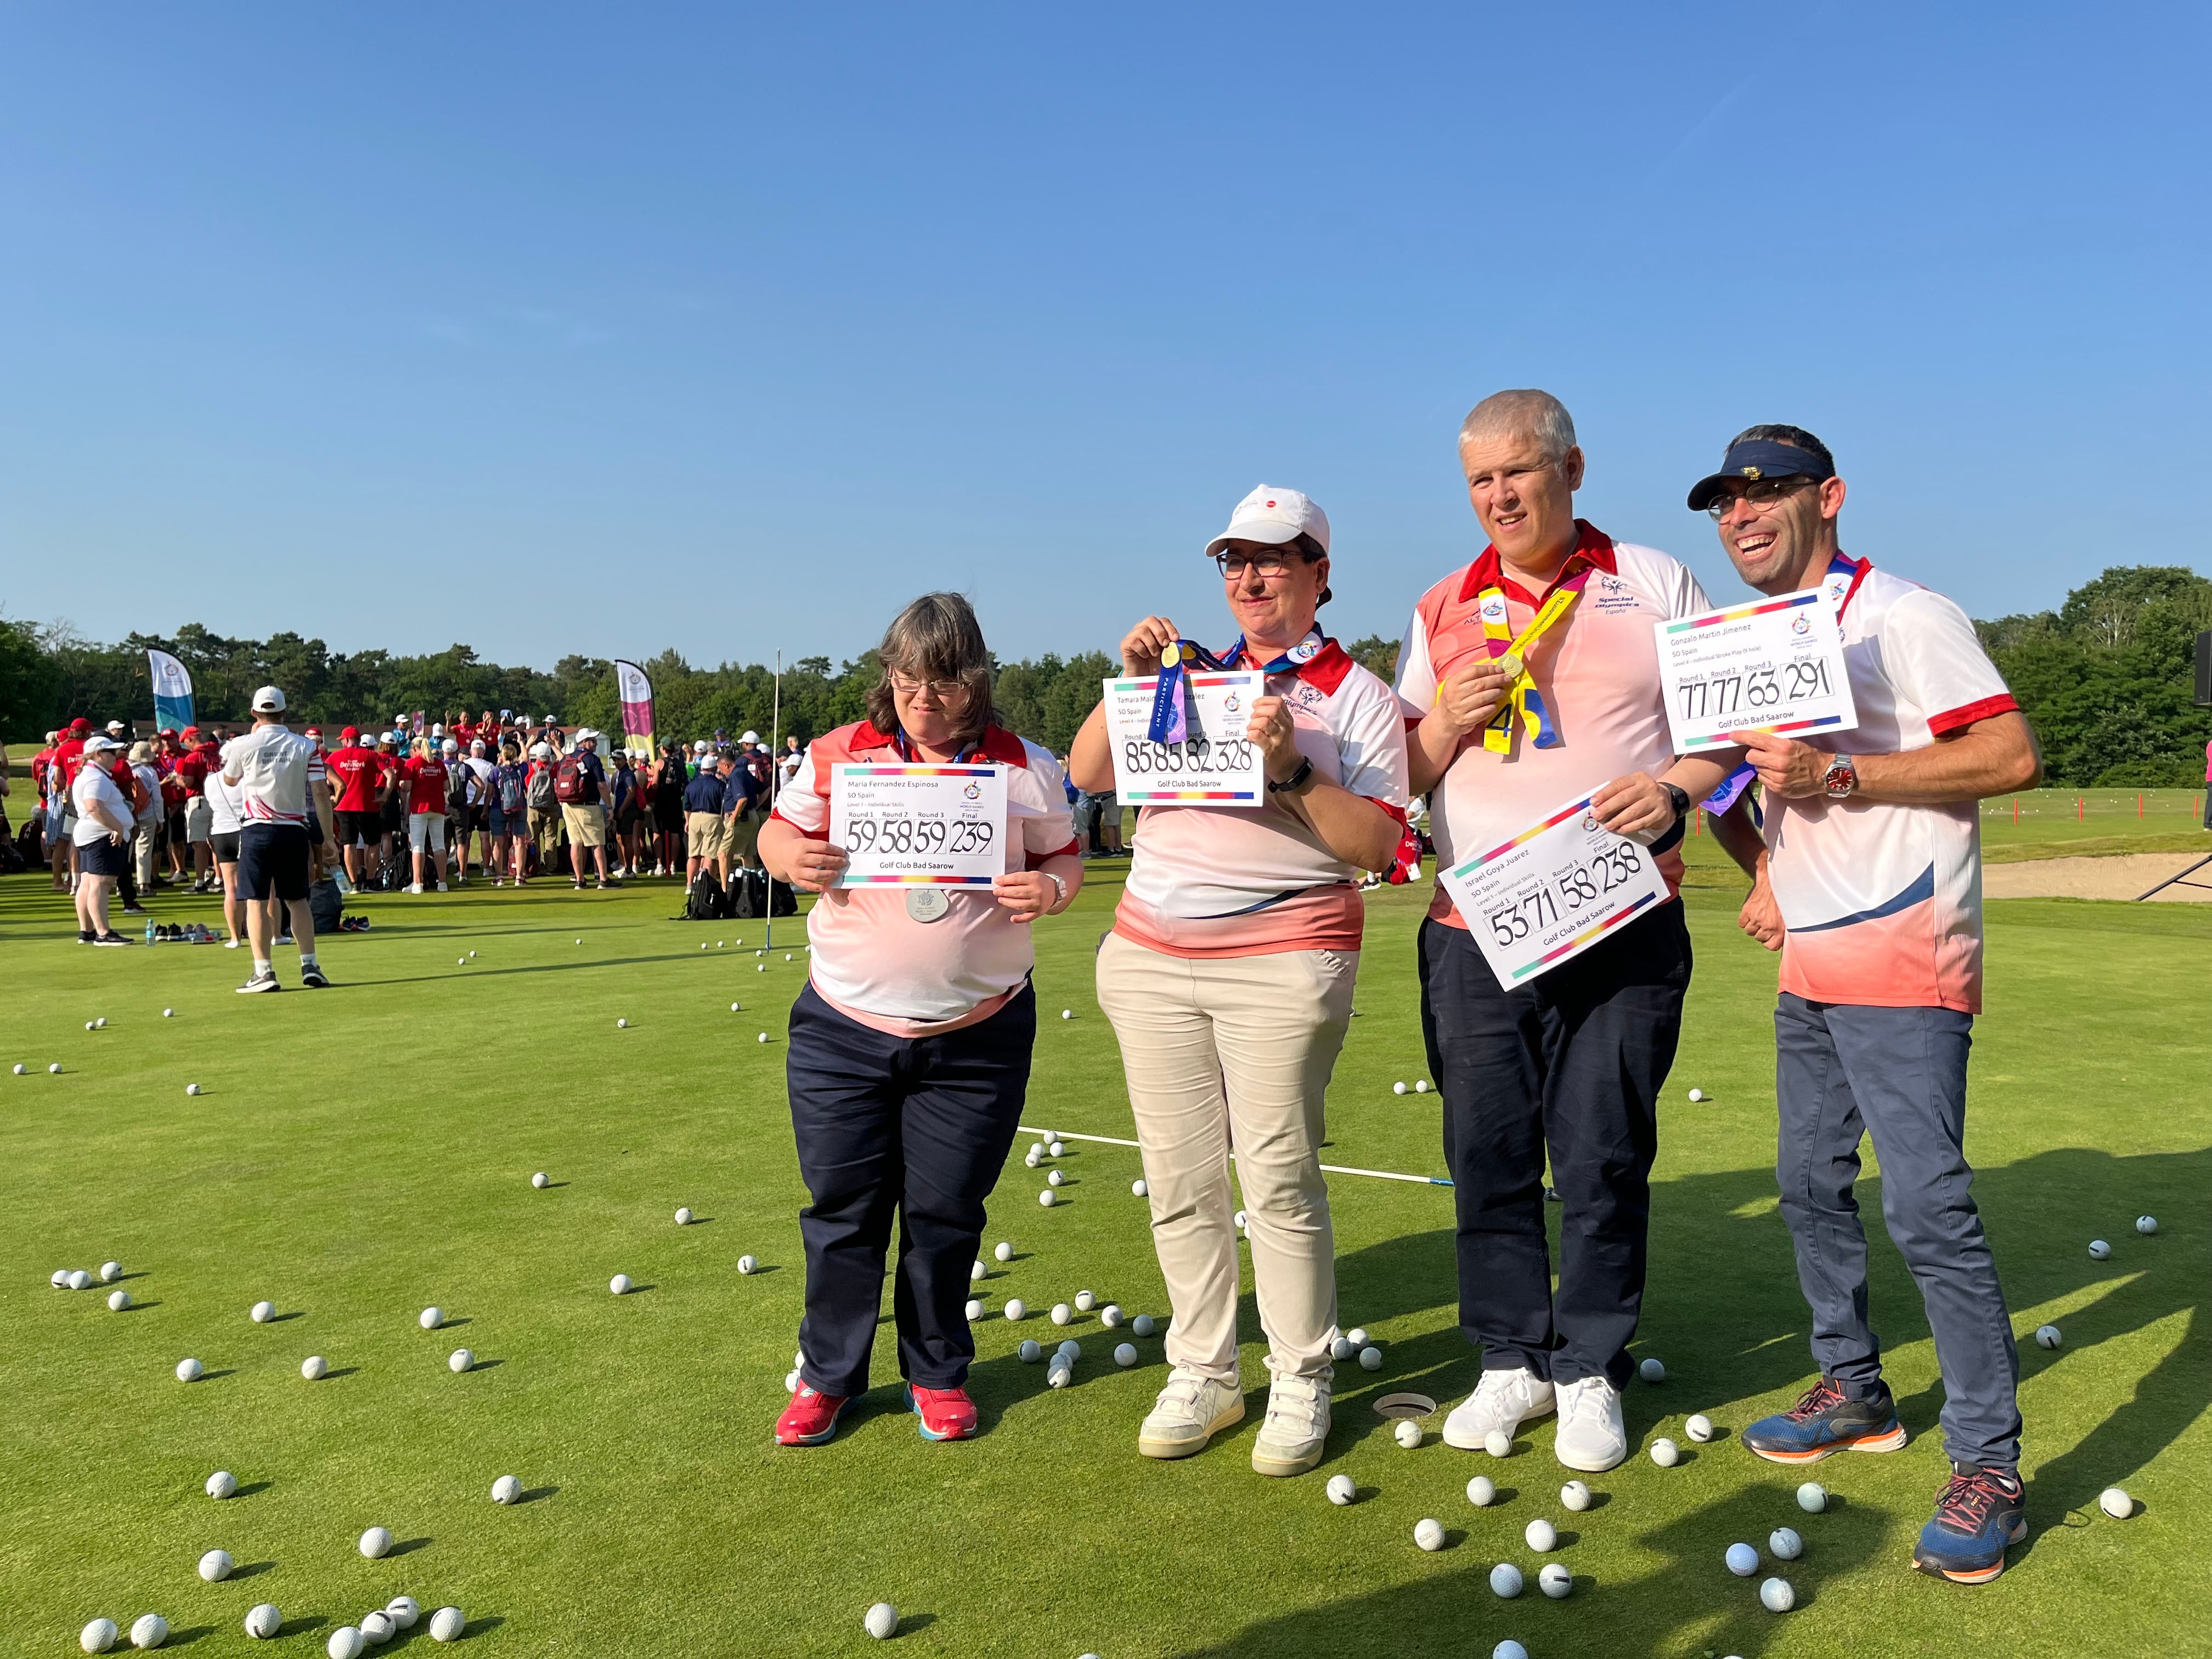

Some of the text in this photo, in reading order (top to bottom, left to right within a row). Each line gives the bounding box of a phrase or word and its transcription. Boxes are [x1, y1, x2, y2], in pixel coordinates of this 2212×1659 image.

[1671, 624, 1752, 646] Gonzalo Martin Jimenez
[1681, 648, 1698, 656] Spain
[1693, 654, 1715, 663] Individual
[1794, 653, 1811, 662] Final
[1711, 669, 1731, 677] Round
[1745, 662, 1765, 671] Round
[1679, 675, 1698, 683] Round
[1679, 658, 1830, 719] 77 77 63 291
[1155, 677, 1169, 727] PARTICIPANT
[1718, 711, 1794, 729] Golf Club Bad Saarow
[1126, 738, 1252, 774] 85 85 82 328
[846, 820, 993, 854] 59 58 59 239
[1593, 841, 1609, 854] Final
[1465, 849, 1530, 888] Israel Goya Juarez
[1551, 863, 1573, 878] Round
[1471, 879, 1500, 898] SO Spain
[1476, 896, 1490, 907] Level
[1497, 879, 1522, 895] Individual
[1521, 872, 1535, 883] Skills
[1491, 841, 1641, 946] 53 71 58 238
[1517, 882, 1539, 897] Round
[1482, 900, 1505, 916] Round
[1543, 901, 1616, 946] Golf Club Bad Saarow
